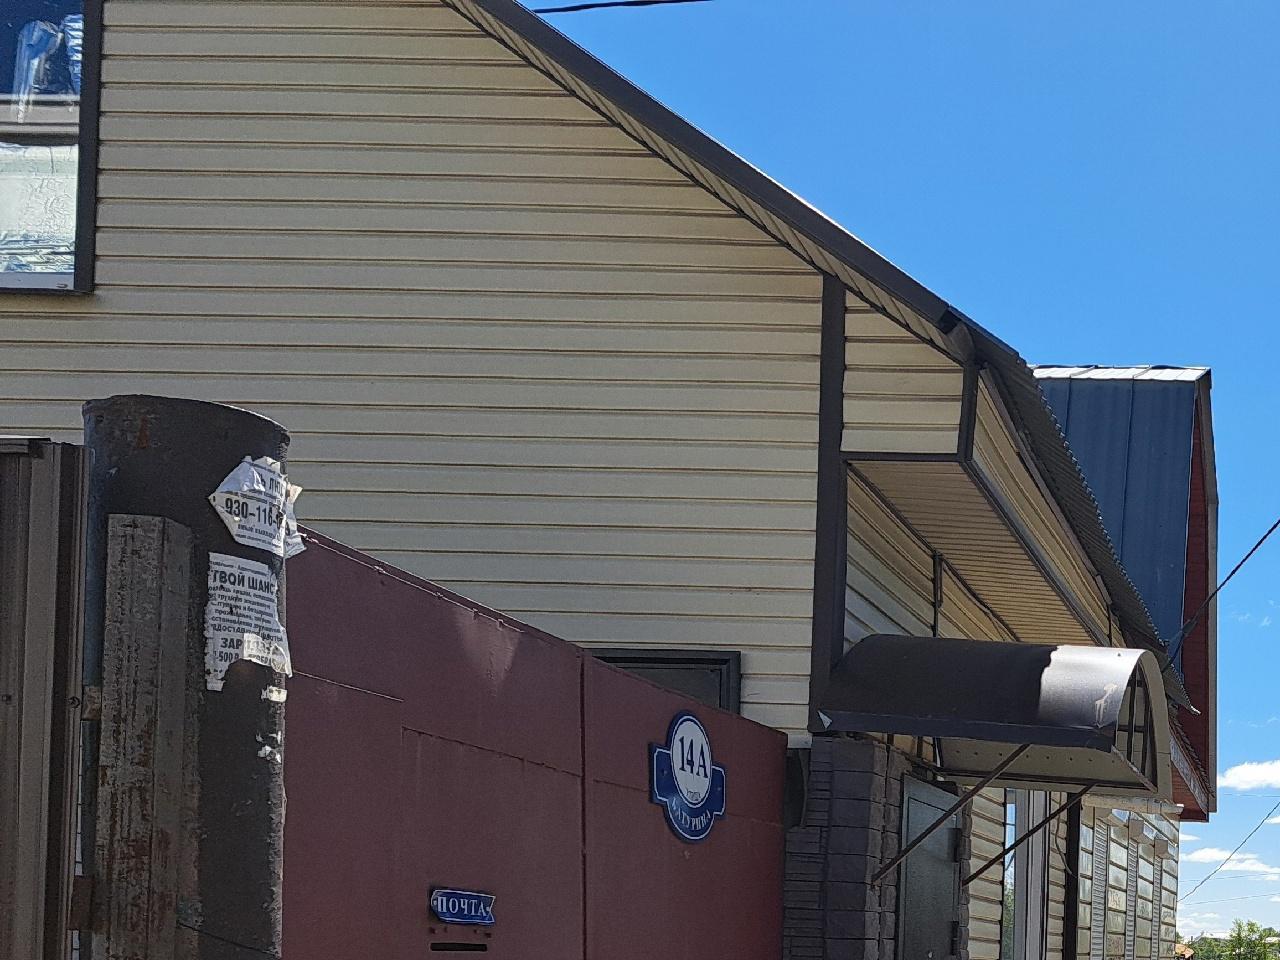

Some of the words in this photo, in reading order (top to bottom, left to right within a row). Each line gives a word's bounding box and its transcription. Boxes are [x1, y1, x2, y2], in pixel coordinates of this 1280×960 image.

[212, 569, 245, 588] ТВОЙ
[247, 576, 275, 595] ШАНС
[679, 735, 709, 779] 14А
[437, 896, 487, 917] ПОЧТА
